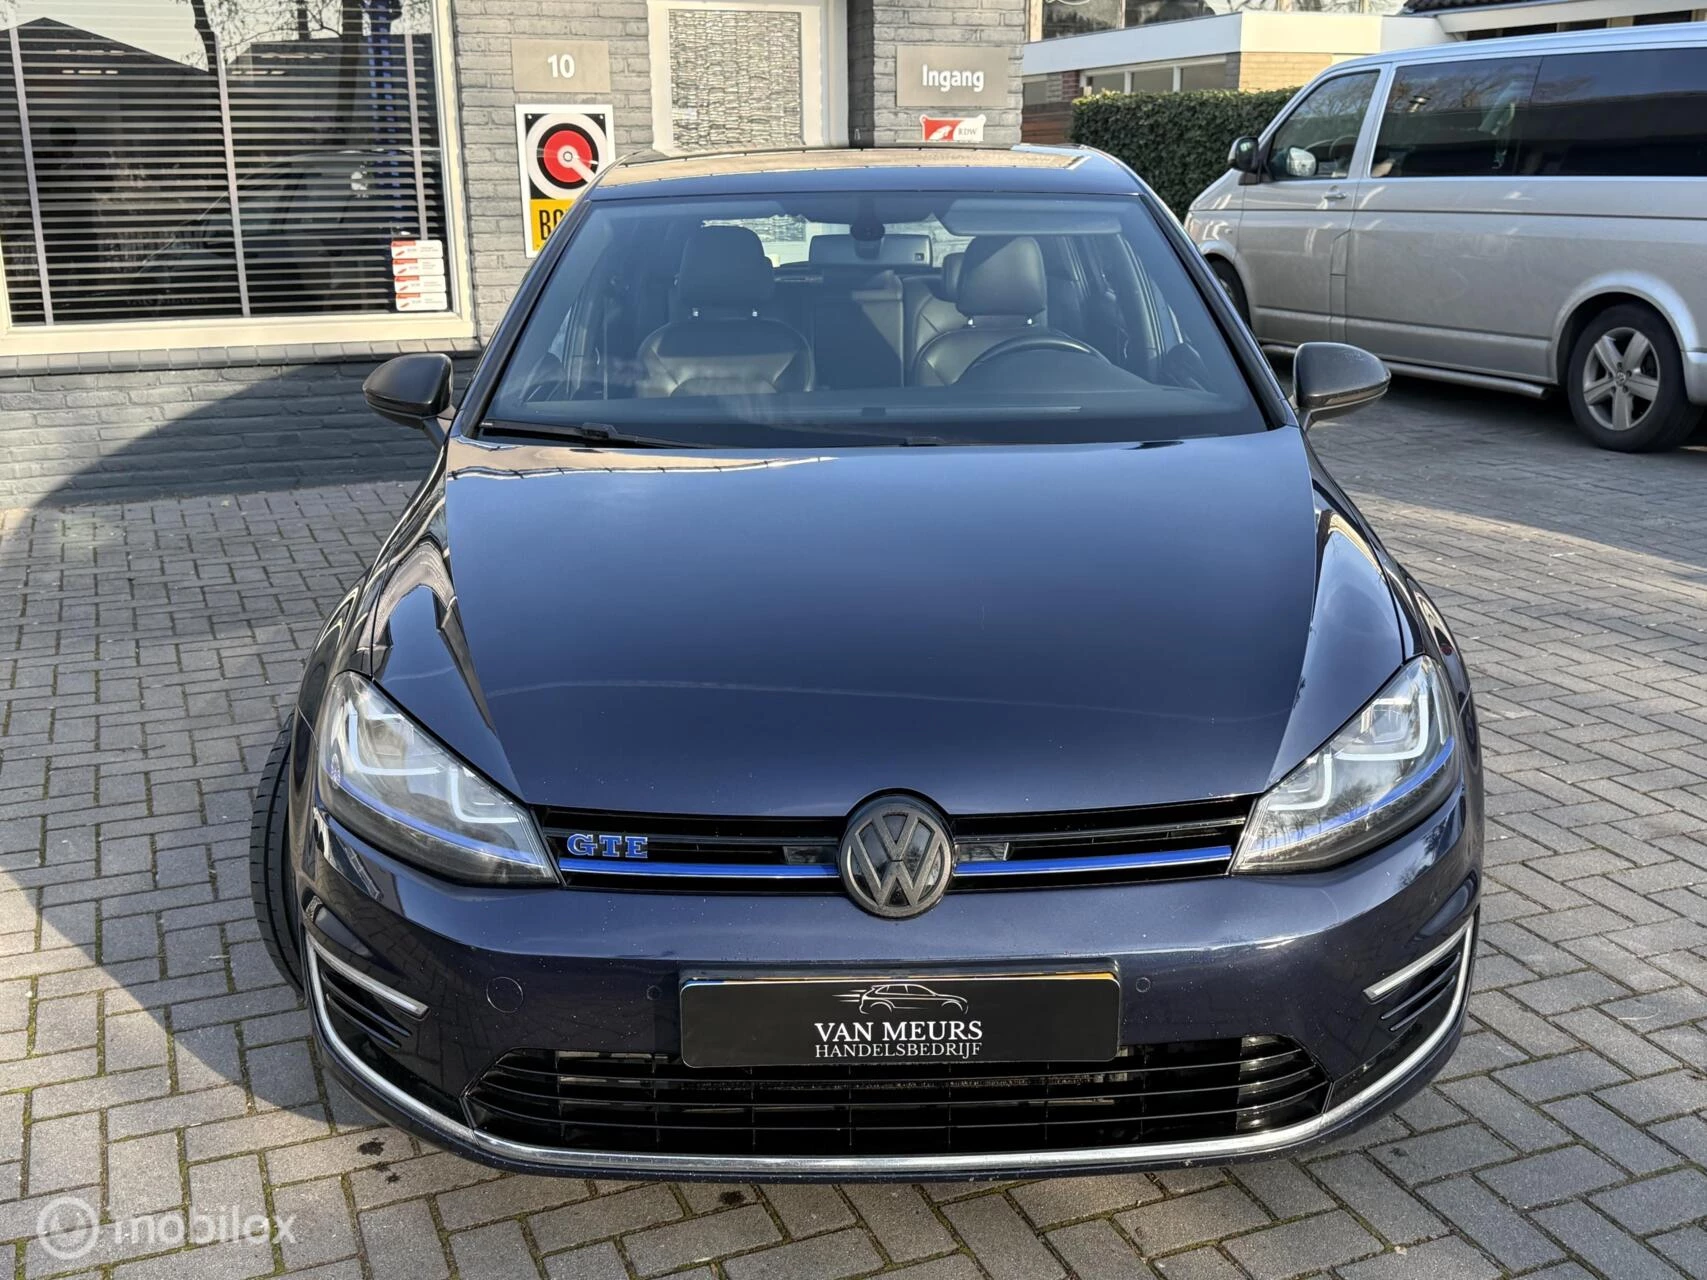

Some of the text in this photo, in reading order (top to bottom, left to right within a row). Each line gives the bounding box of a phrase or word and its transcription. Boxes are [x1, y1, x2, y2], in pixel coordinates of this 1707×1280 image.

[547, 54, 576, 79] 10
[922, 64, 984, 92] Ingang
[566, 833, 649, 859] GTE
[814, 1020, 983, 1043] VAN MEURS
[815, 1042, 983, 1059] HANDELSBEDRIJF
